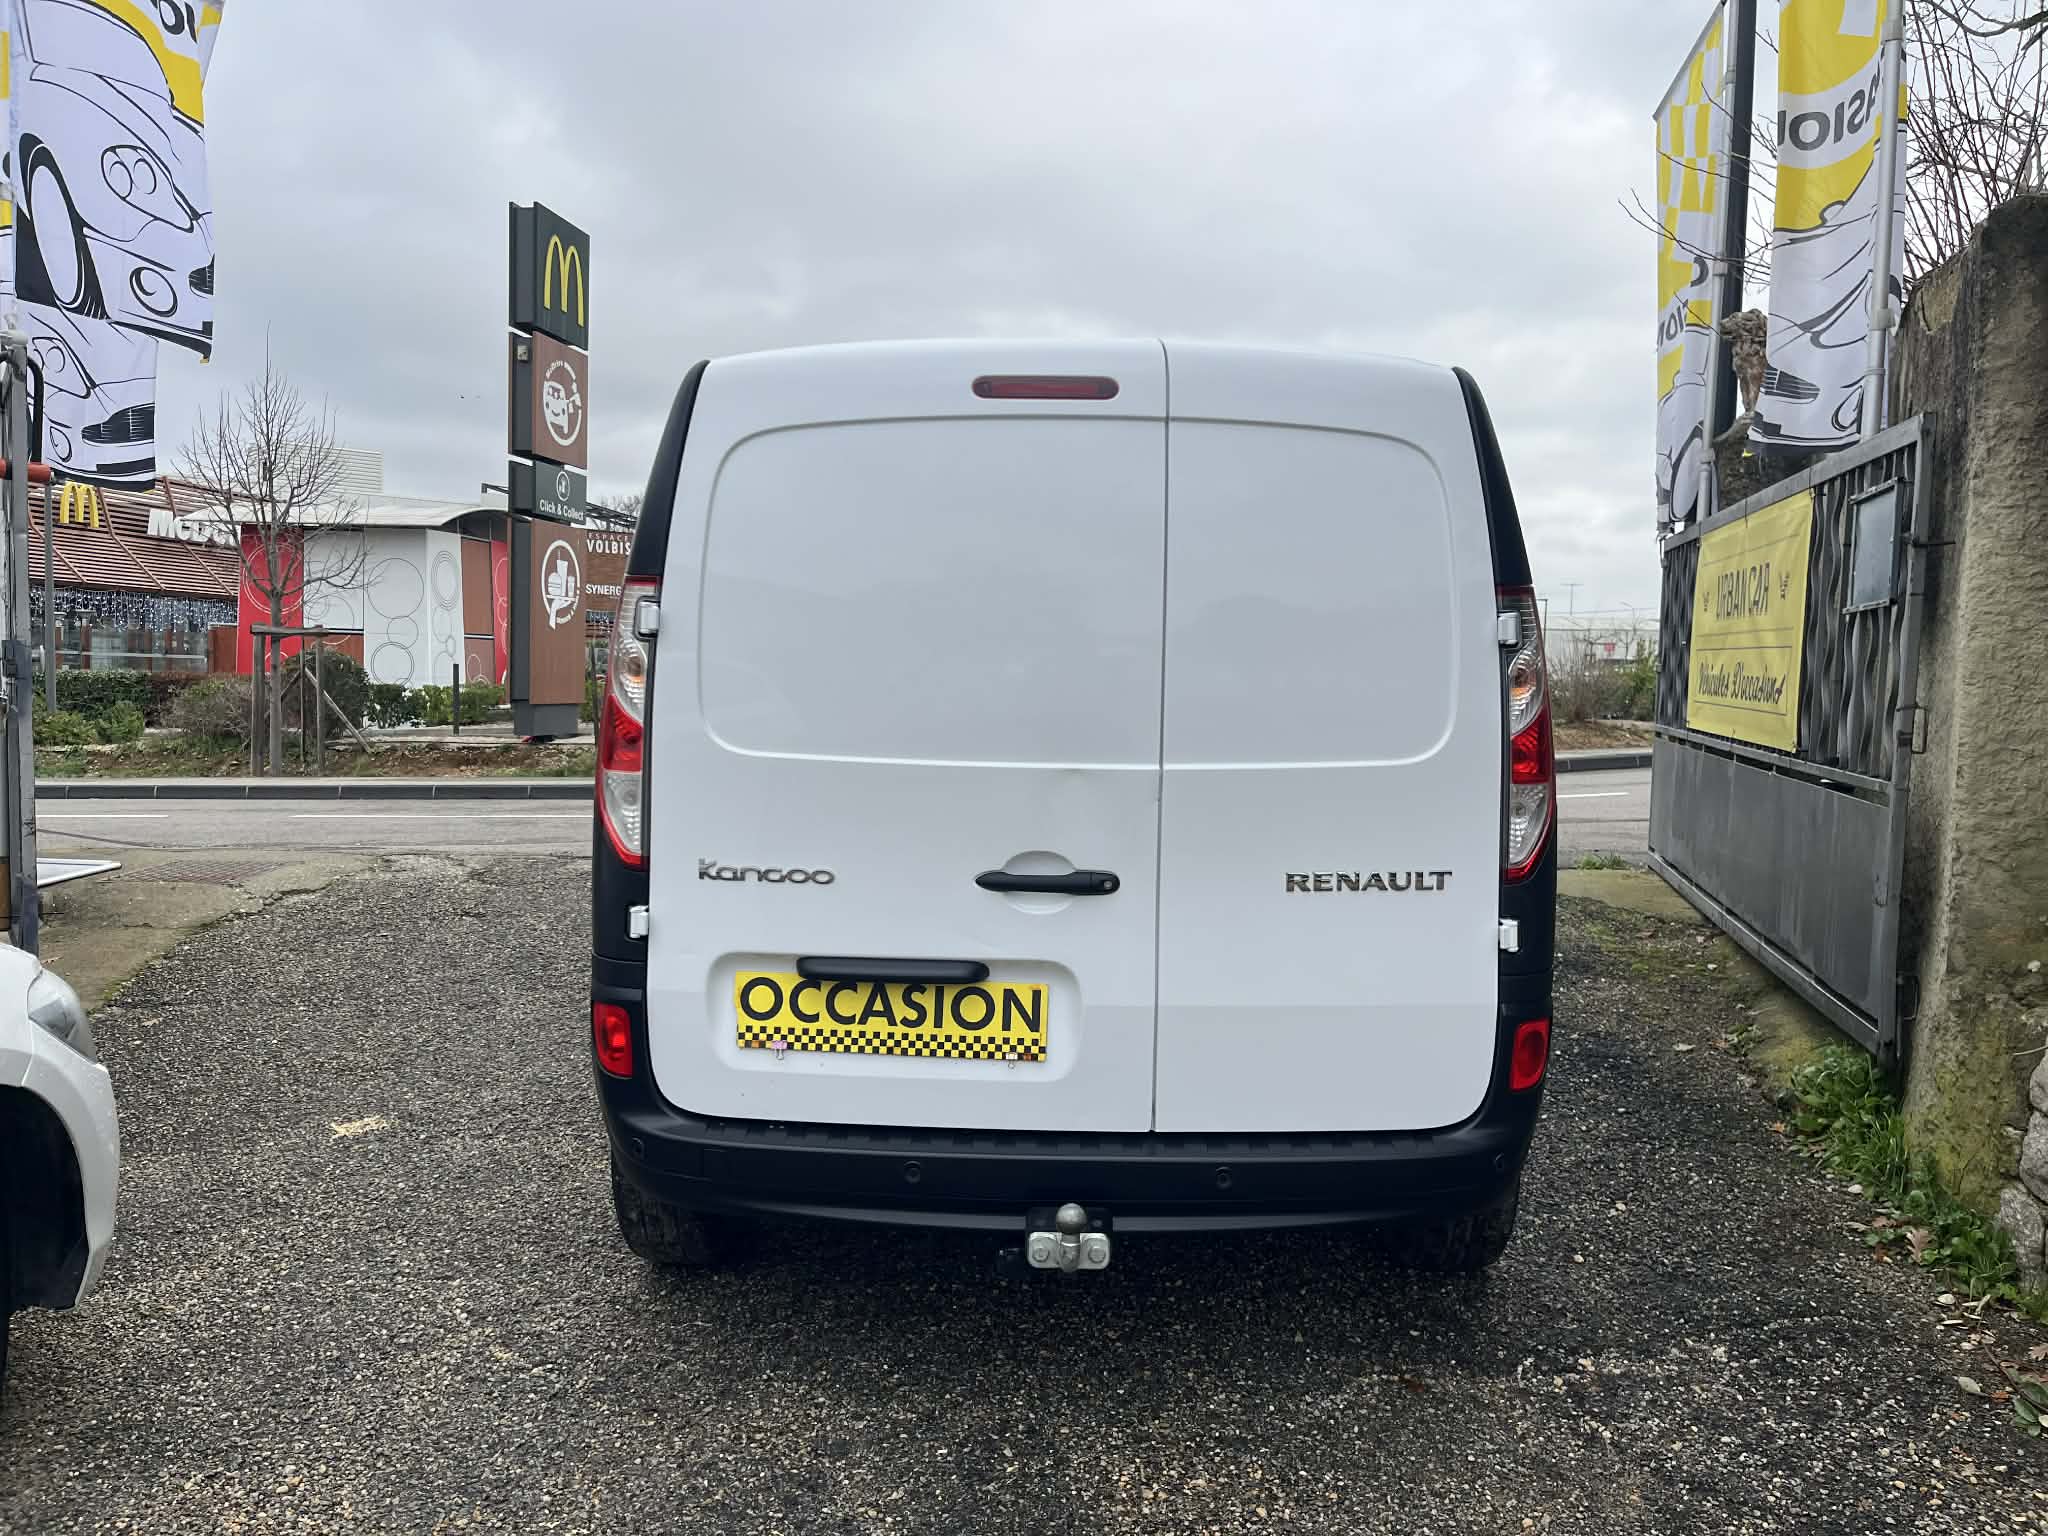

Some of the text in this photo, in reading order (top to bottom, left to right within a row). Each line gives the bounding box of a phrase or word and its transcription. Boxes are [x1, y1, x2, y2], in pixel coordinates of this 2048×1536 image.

[539, 499, 584, 521] Click & Collect
[586, 539, 631, 555] VOLBIS
[1716, 562, 1770, 620] URBAN CAR
[698, 857, 835, 885] Kangoo
[1285, 871, 1453, 892] RENAULT
[739, 975, 1041, 1032] OCCASION
